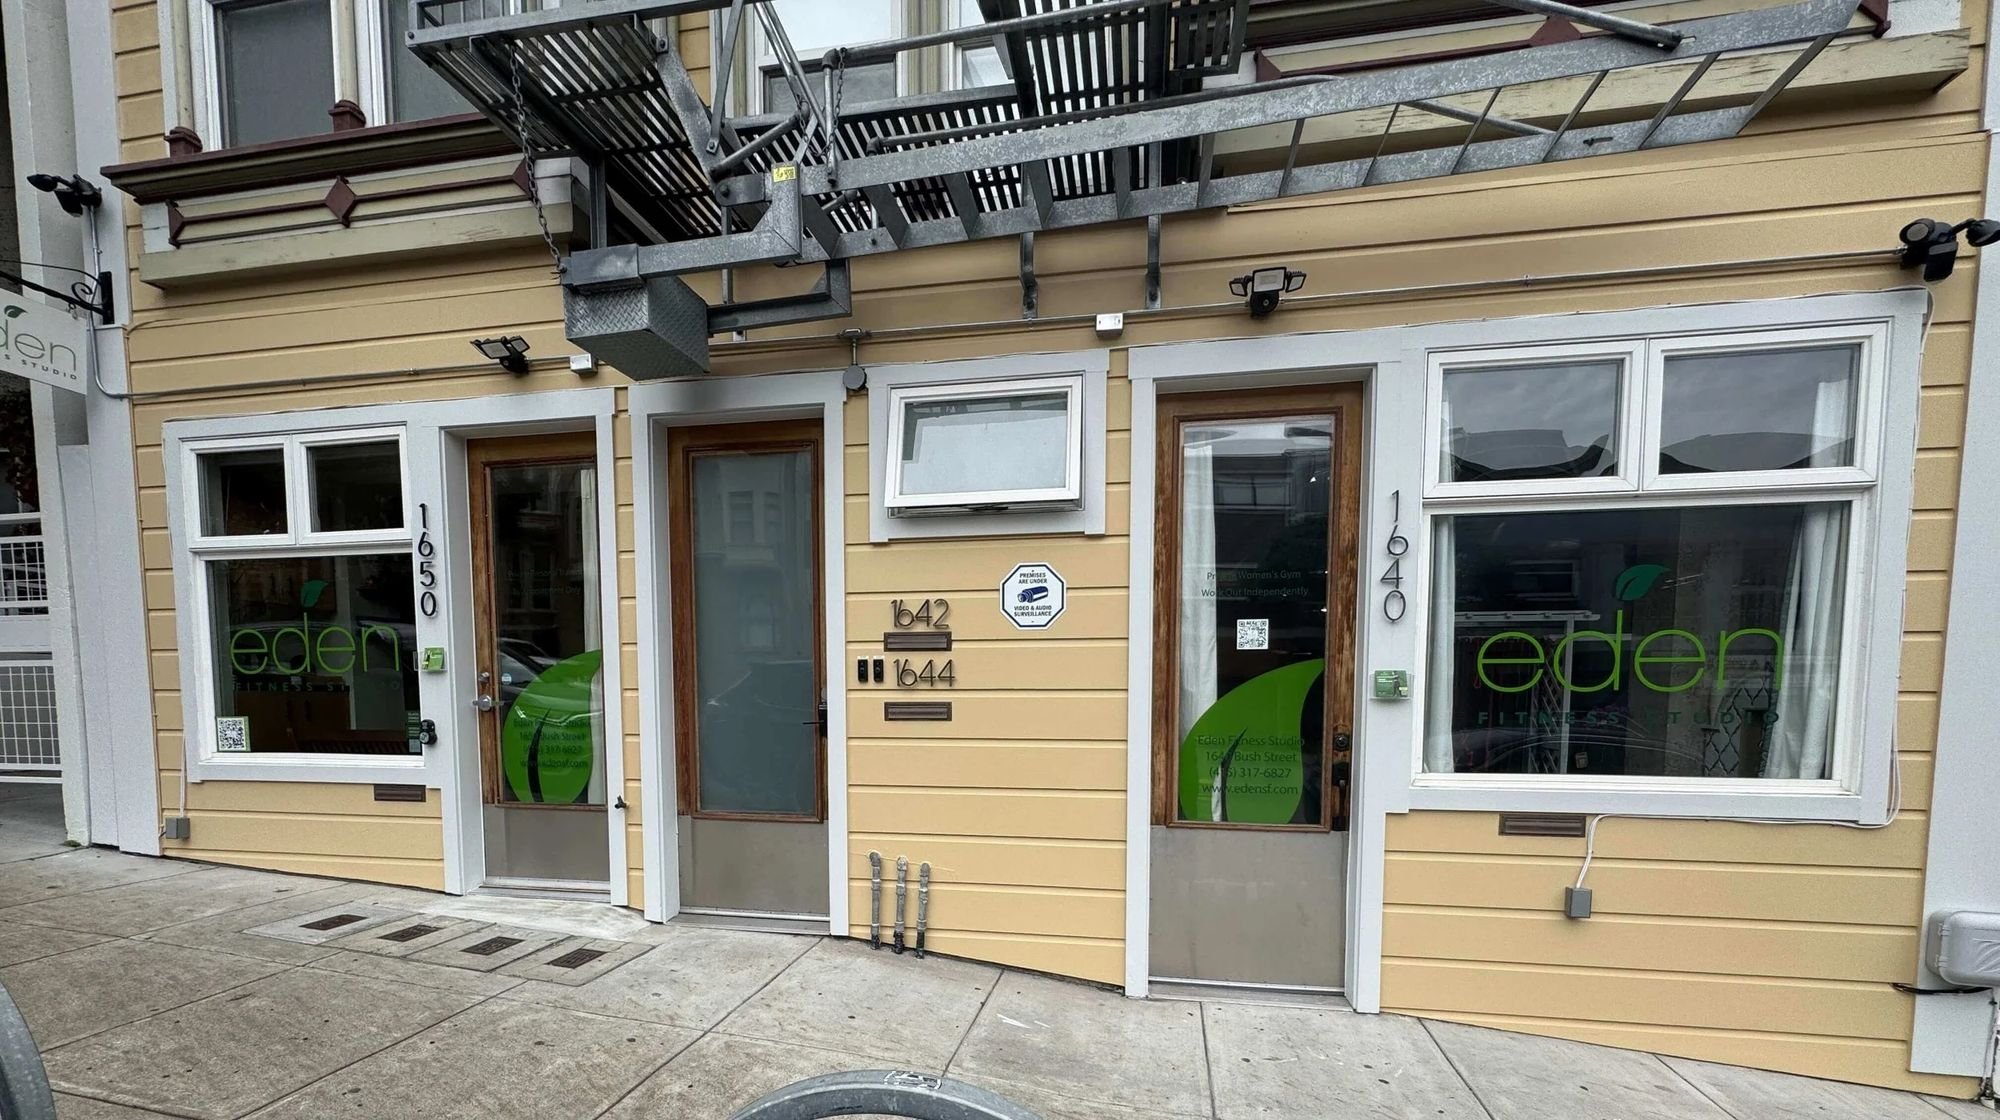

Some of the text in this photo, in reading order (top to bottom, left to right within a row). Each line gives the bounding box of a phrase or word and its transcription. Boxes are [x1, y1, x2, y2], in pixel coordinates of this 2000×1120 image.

[21, 359, 77, 380] STUDIO
[418, 503, 437, 617] 1650
[1380, 490, 1409, 622] 1640
[1239, 569, 1278, 579] Women's
[1280, 569, 1302, 580] Gym
[1243, 586, 1309, 597] Independently
[890, 598, 950, 629] 1642
[231, 612, 400, 674] eden
[1477, 609, 1784, 692] eden
[893, 658, 956, 687] 1644
[235, 681, 313, 692] FITNESS
[1478, 711, 1779, 725] FITNESS TUDIO
[1198, 735, 1305, 746] Eden Fness Studio
[1206, 751, 1297, 762] 164 Bush Street
[1240, 767, 1292, 778] 317-6827
